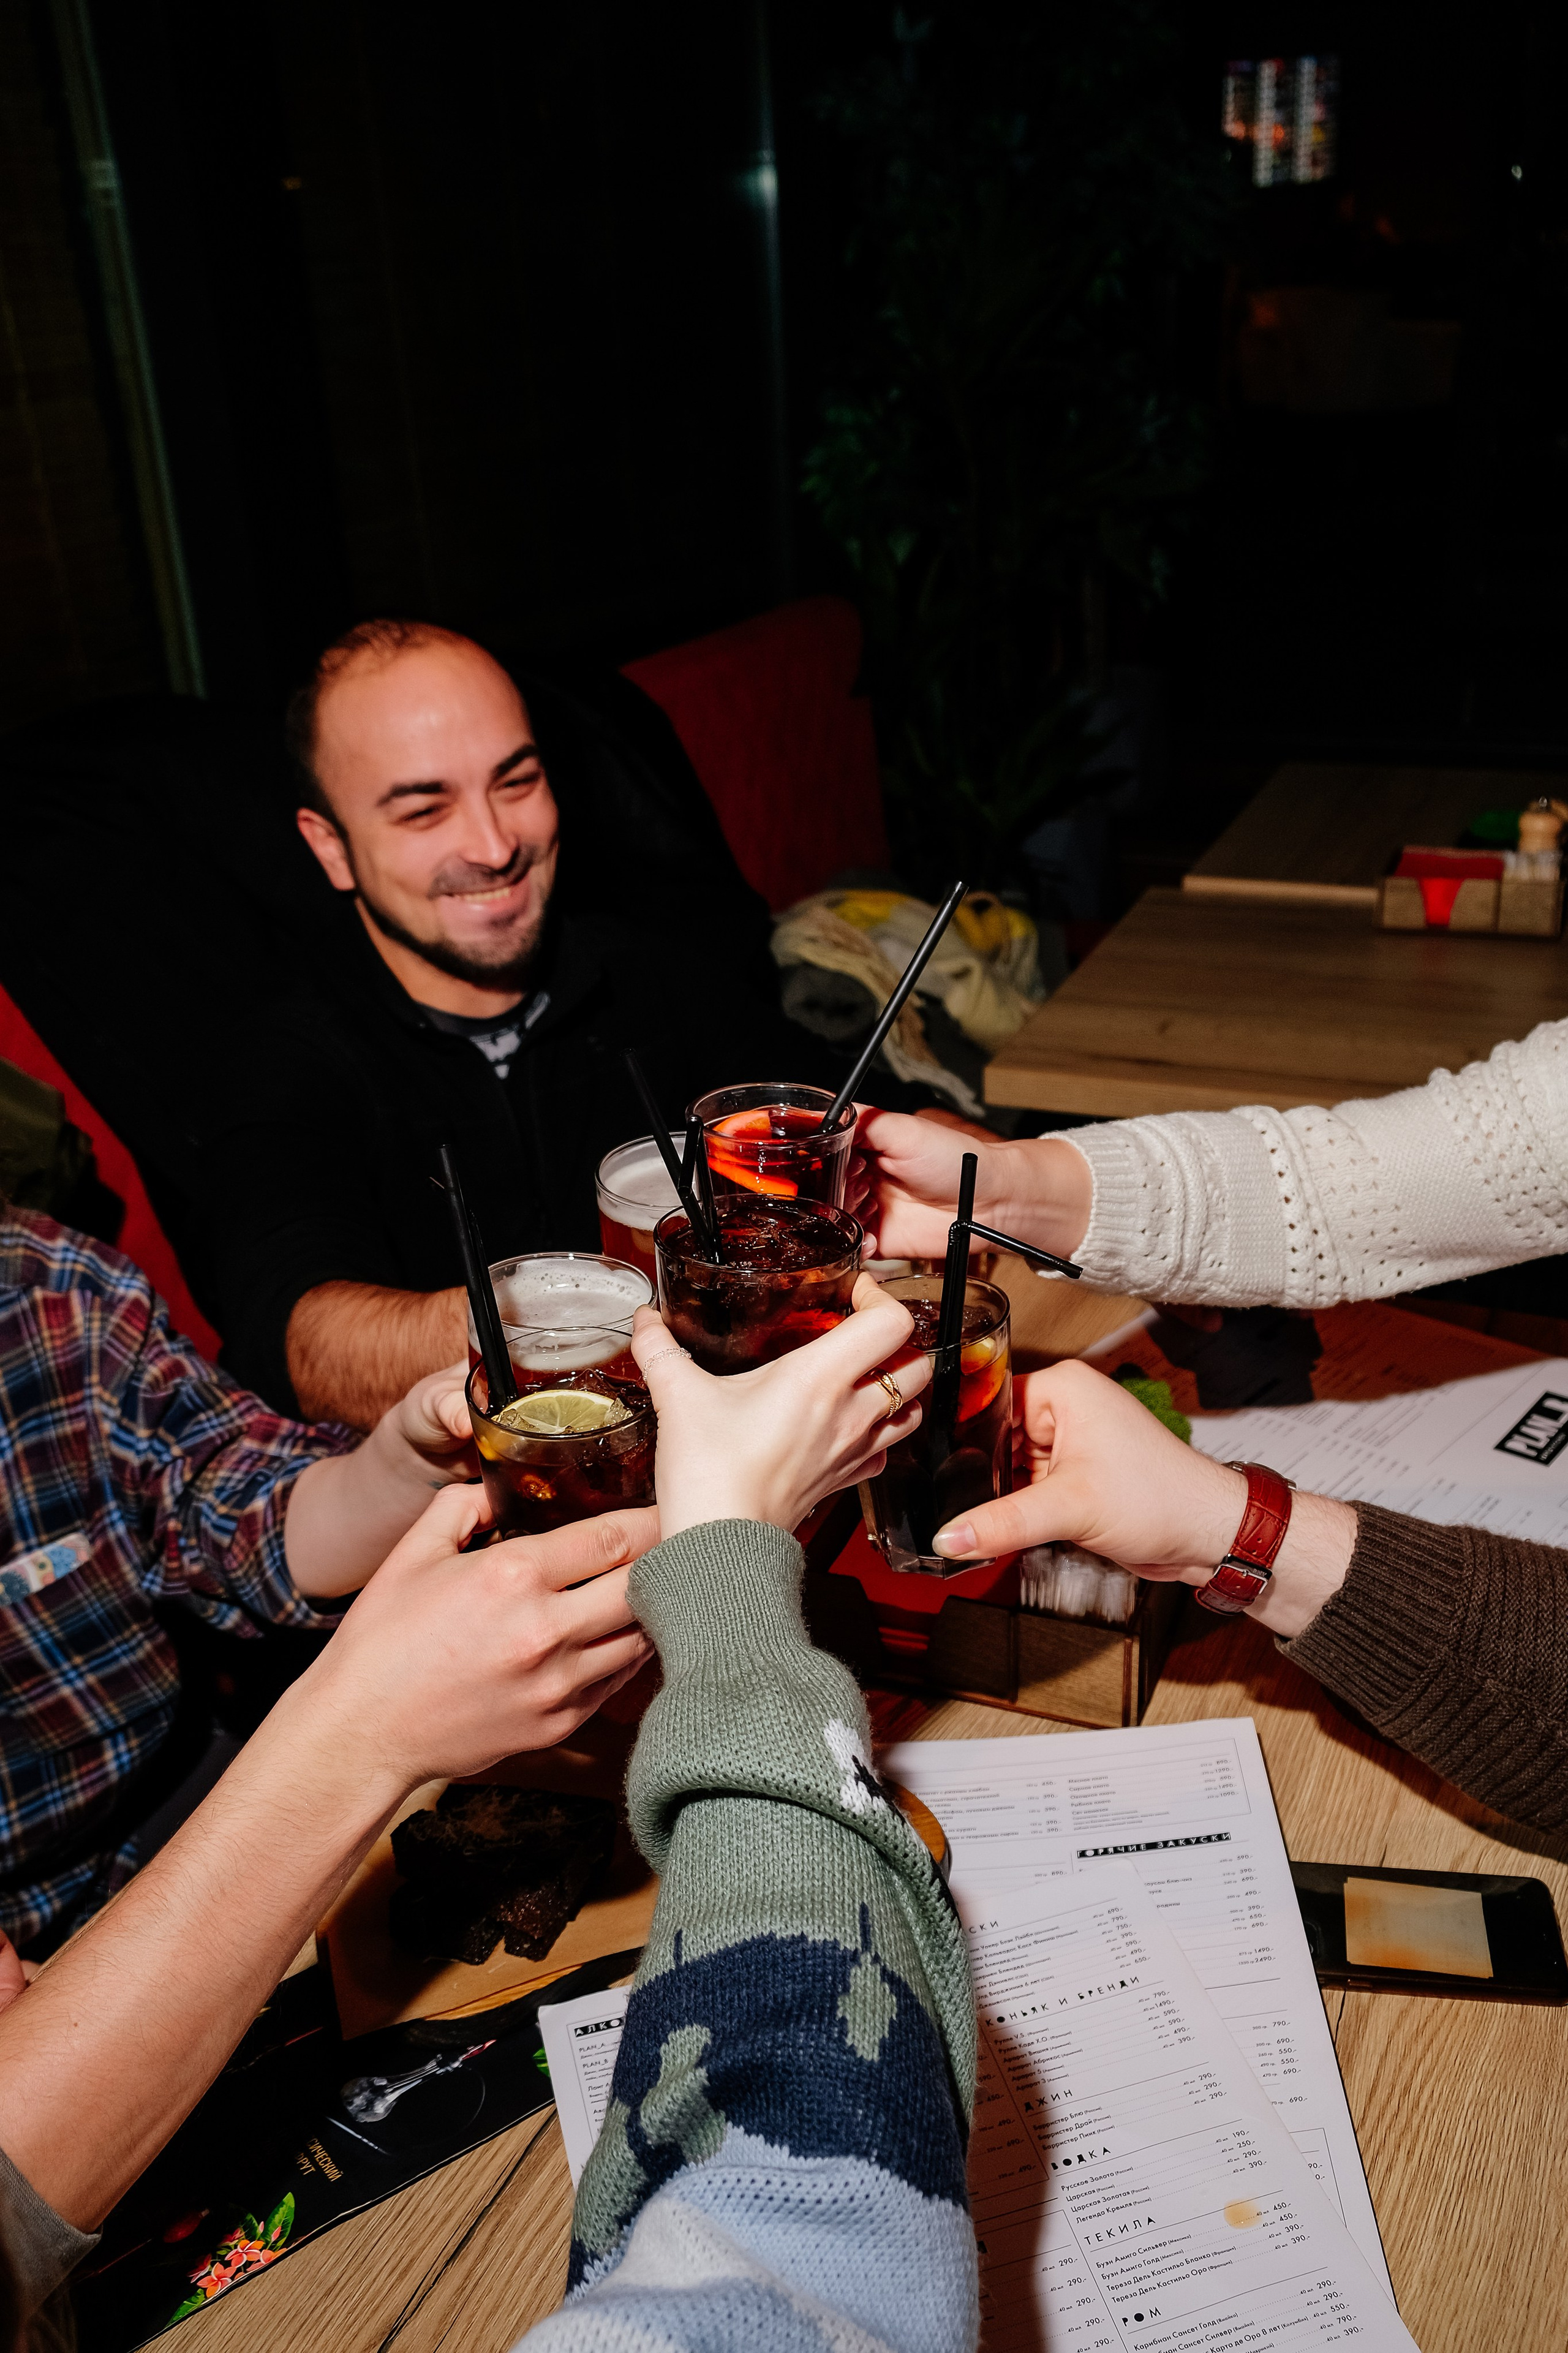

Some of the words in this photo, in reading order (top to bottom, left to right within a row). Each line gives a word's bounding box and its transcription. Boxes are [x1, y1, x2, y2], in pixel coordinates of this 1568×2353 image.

[1077, 1844, 1147, 1858] ГОРЯЧИЕ
[1157, 1832, 1231, 1849] ЗАКУСКИ
[969, 1921, 998, 1933] СКИ
[986, 2004, 1049, 2026] КОНЬЯК
[1077, 1976, 1139, 2000] БРЕНДИ
[1155, 2000, 1175, 2008] 1490.-
[576, 2019, 620, 2037] АЛКО
[1204, 2082, 1221, 2090] 290.-
[1209, 2091, 1227, 2099] 290.-
[1024, 2090, 1072, 2113] ДЖИН
[1237, 2140, 1255, 2148] 250.-
[1243, 2150, 1261, 2158] 290.-
[307, 2138, 344, 2181] СИЧЕСКИЙ
[1051, 2147, 1110, 2170] ВОДКА
[1076, 2211, 1105, 2224] Легенда
[1106, 2202, 1133, 2213] Кремля
[1084, 2217, 1155, 2245] ТЕКИЛА
[1096, 2260, 1114, 2268] Буэн
[1115, 2252, 1137, 2262] Амиго
[1137, 2242, 1167, 2254] Сильвер
[1101, 2272, 1118, 2280] Буэн
[1120, 2264, 1142, 2274] Амиго
[1142, 2257, 1161, 2266] Голд
[1280, 2213, 1297, 2221] 450.-
[1058, 2257, 1077, 2267] 290.-
[1106, 2280, 1132, 2291] Тереза
[1133, 2275, 1151, 2284] Дель
[1151, 2262, 1184, 2276] Кастильо
[1185, 2254, 1211, 2264] Бланко
[1284, 2224, 1304, 2233] 390.-
[1111, 2292, 1137, 2303] Тереза
[1138, 2286, 1156, 2296] Дель
[1156, 2274, 1190, 2288] Кастильо
[1291, 2235, 1310, 2244] 390.-
[1067, 2277, 1087, 2286] 290.-
[1076, 2297, 1096, 2306] 290.-
[1085, 2317, 1105, 2327] 290.-
[1121, 2307, 1161, 2327] РОМ
[1134, 2336, 1172, 2351] Карибиан
[1172, 2327, 1198, 2338] Сансет
[1199, 2321, 1217, 2329] Голд
[1316, 2279, 1336, 2289] 290.-
[1178, 2338, 1204, 2350] Сансет
[1205, 2329, 1232, 2341] Силвер
[1323, 2291, 1343, 2301] 290.-
[1244, 2333, 1261, 2341] Оро
[1330, 2303, 1349, 2313] 550.-
[1336, 2314, 1357, 2324] 790.-
[1343, 2327, 1363, 2336] 390.-
[1094, 2338, 1114, 2347] 290.-
